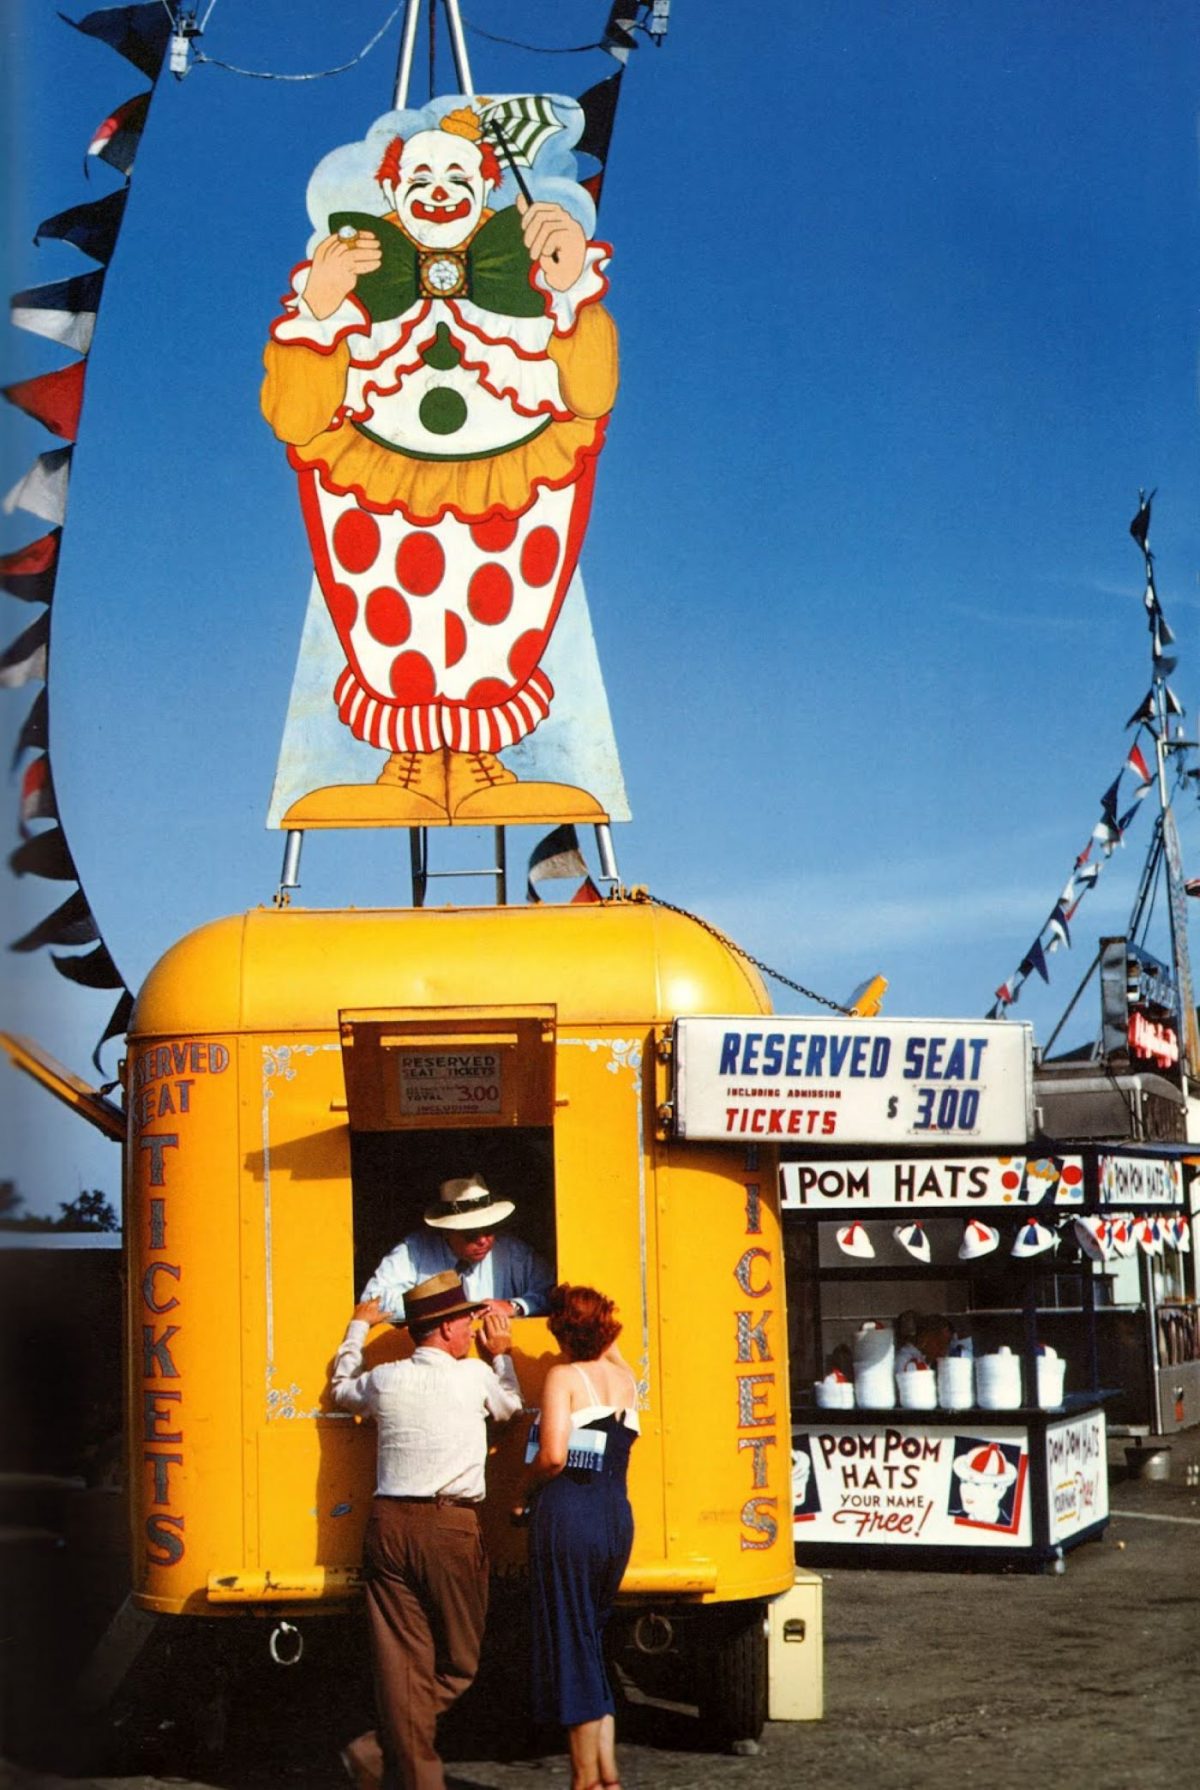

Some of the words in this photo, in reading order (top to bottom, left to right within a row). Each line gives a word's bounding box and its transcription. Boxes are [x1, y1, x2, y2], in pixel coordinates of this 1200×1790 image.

[135, 1042, 230, 1088] SERVED
[402, 1056, 496, 1068] RESERVED
[446, 1067, 496, 1076] TICKETS
[719, 1032, 892, 1078] RESERVED
[902, 1036, 989, 1080] SEAT
[727, 1087, 781, 1097] INCLUDING
[787, 1089, 842, 1099] ADMISSION
[887, 1095, 899, 1119] $
[912, 1088, 981, 1131] 3.00
[725, 1107, 838, 1135] TICKETS
[799, 1165, 870, 1204] POM
[894, 1165, 989, 1202] HATS
[141, 1133, 185, 1567] TICKETS
[818, 1433, 876, 1470] POM
[885, 1428, 943, 1469] POM
[841, 1464, 920, 1490] HATS
[833, 1500, 934, 1538] Free!
[840, 1494, 880, 1508] YOUR
[886, 1495, 925, 1509] NAME
